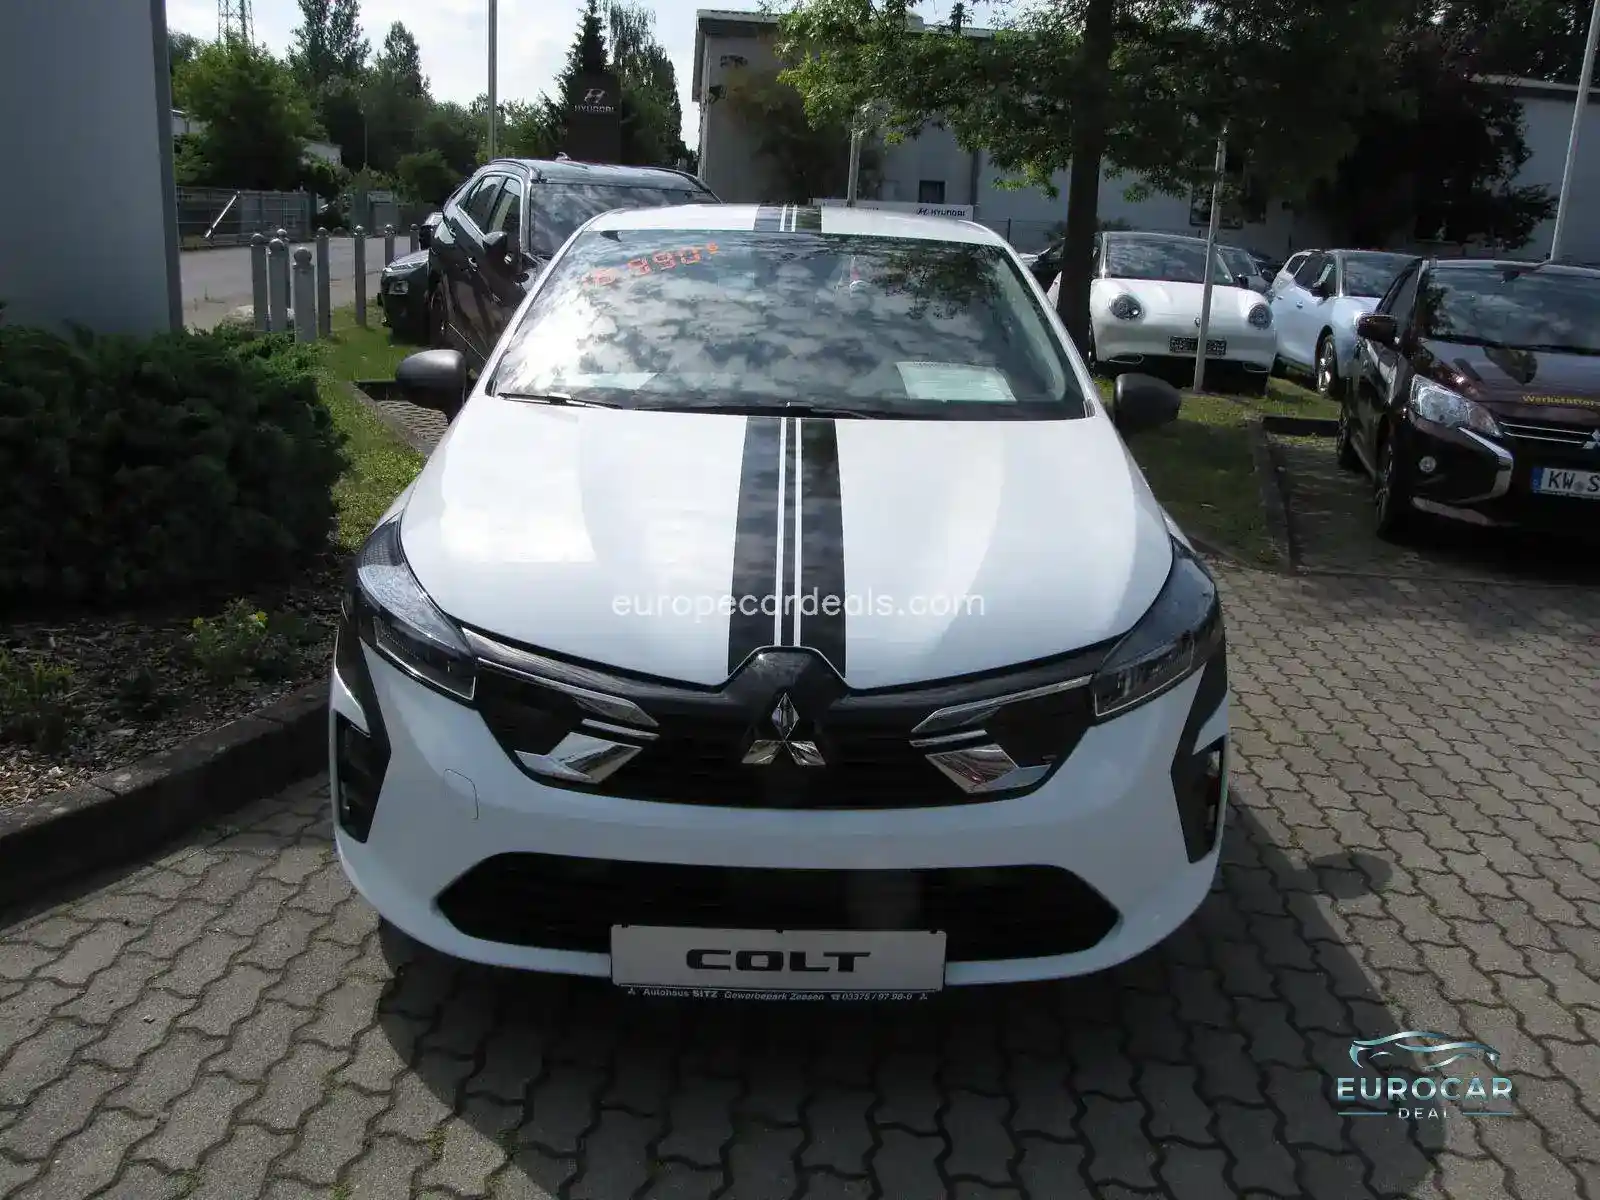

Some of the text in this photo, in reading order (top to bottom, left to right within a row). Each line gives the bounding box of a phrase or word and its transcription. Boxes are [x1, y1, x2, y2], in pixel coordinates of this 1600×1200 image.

[931, 208, 966, 217] HYUNDAI
[1548, 470, 1576, 490] KW
[686, 949, 871, 972] COLT
[643, 987, 690, 998] Autohaus
